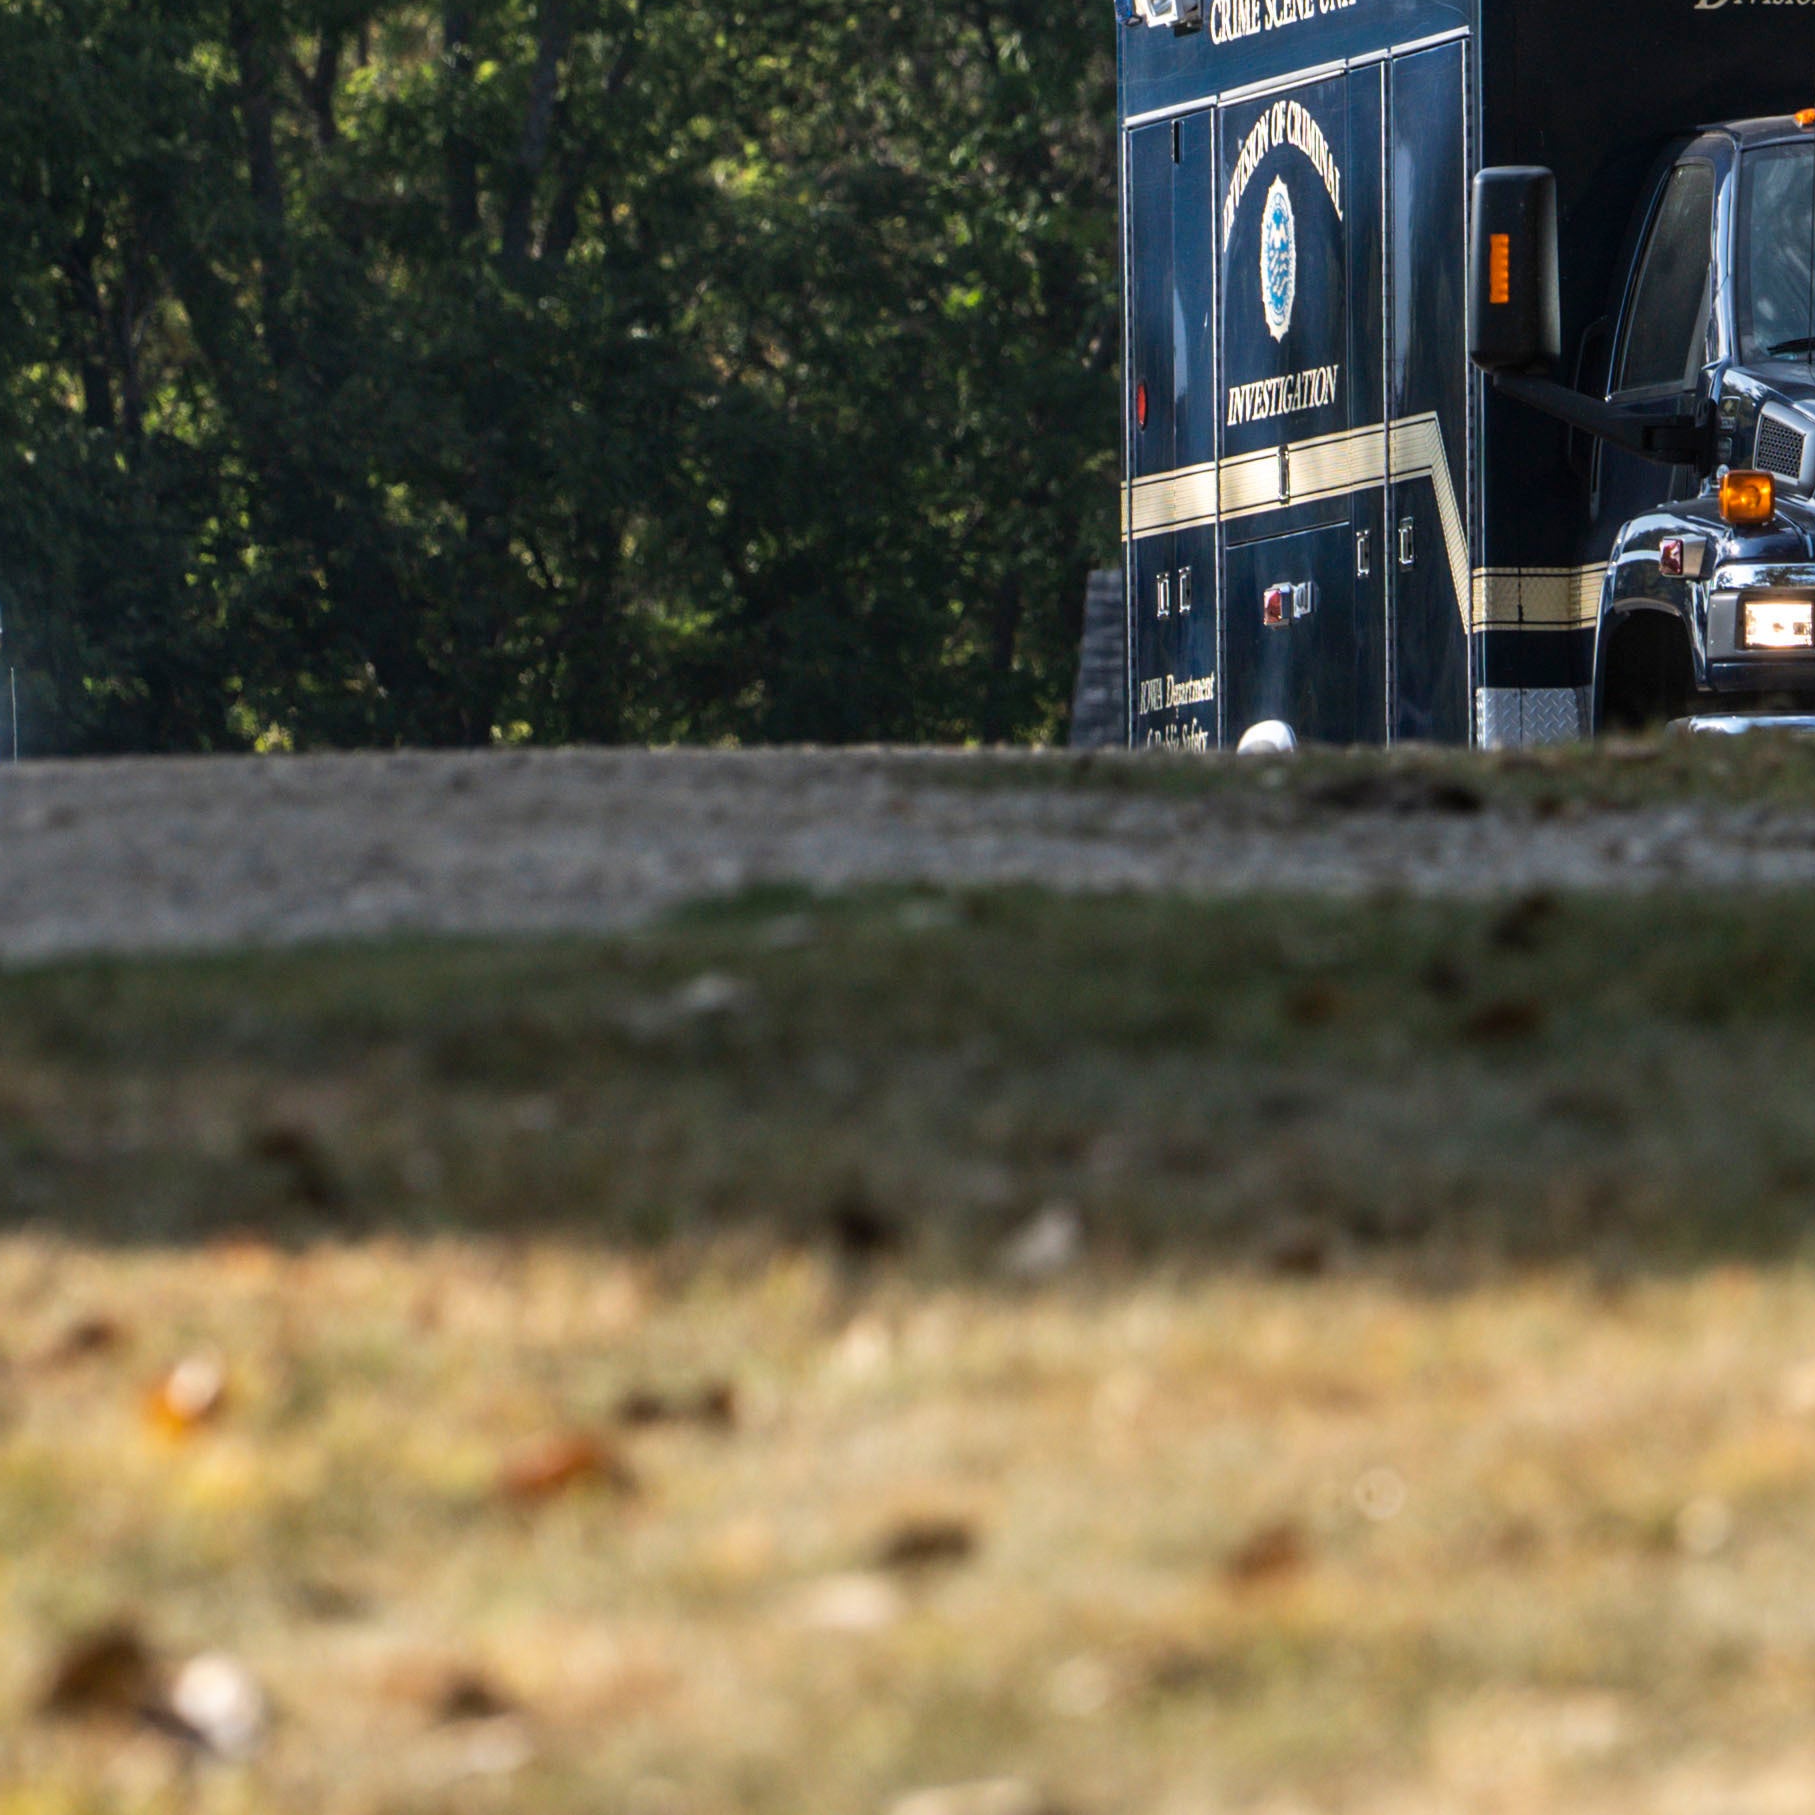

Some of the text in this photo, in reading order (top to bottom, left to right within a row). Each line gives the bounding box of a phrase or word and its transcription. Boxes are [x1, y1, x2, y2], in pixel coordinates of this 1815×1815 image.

[1223, 100, 1343, 253] DIVISION OF CRIMINAL
[1227, 364, 1339, 427] INVESTIGATION
